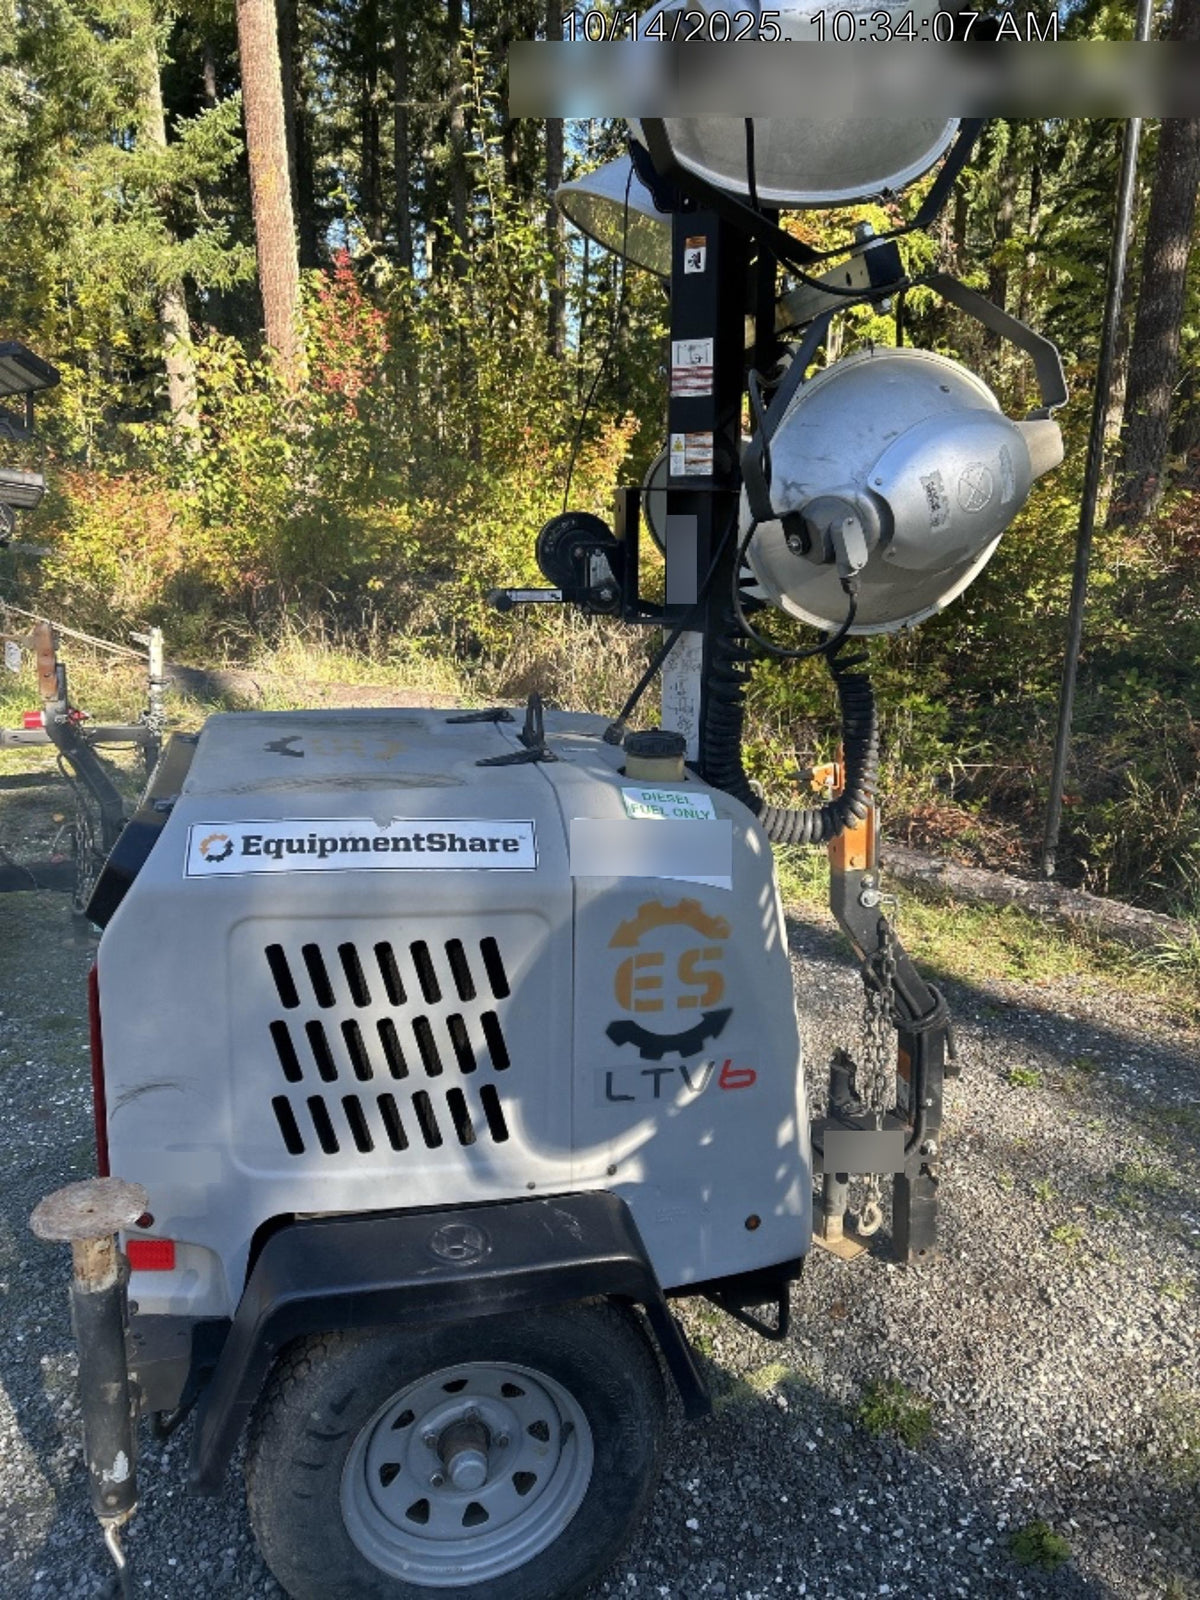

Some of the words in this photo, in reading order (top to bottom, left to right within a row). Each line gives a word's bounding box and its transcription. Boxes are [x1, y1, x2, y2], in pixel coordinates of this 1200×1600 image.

[641, 792, 694, 806] DIESEL
[631, 803, 668, 816] FUEL
[672, 808, 710, 820] ONLY
[240, 832, 520, 861] EquipmentShare
[613, 946, 726, 1013] ES
